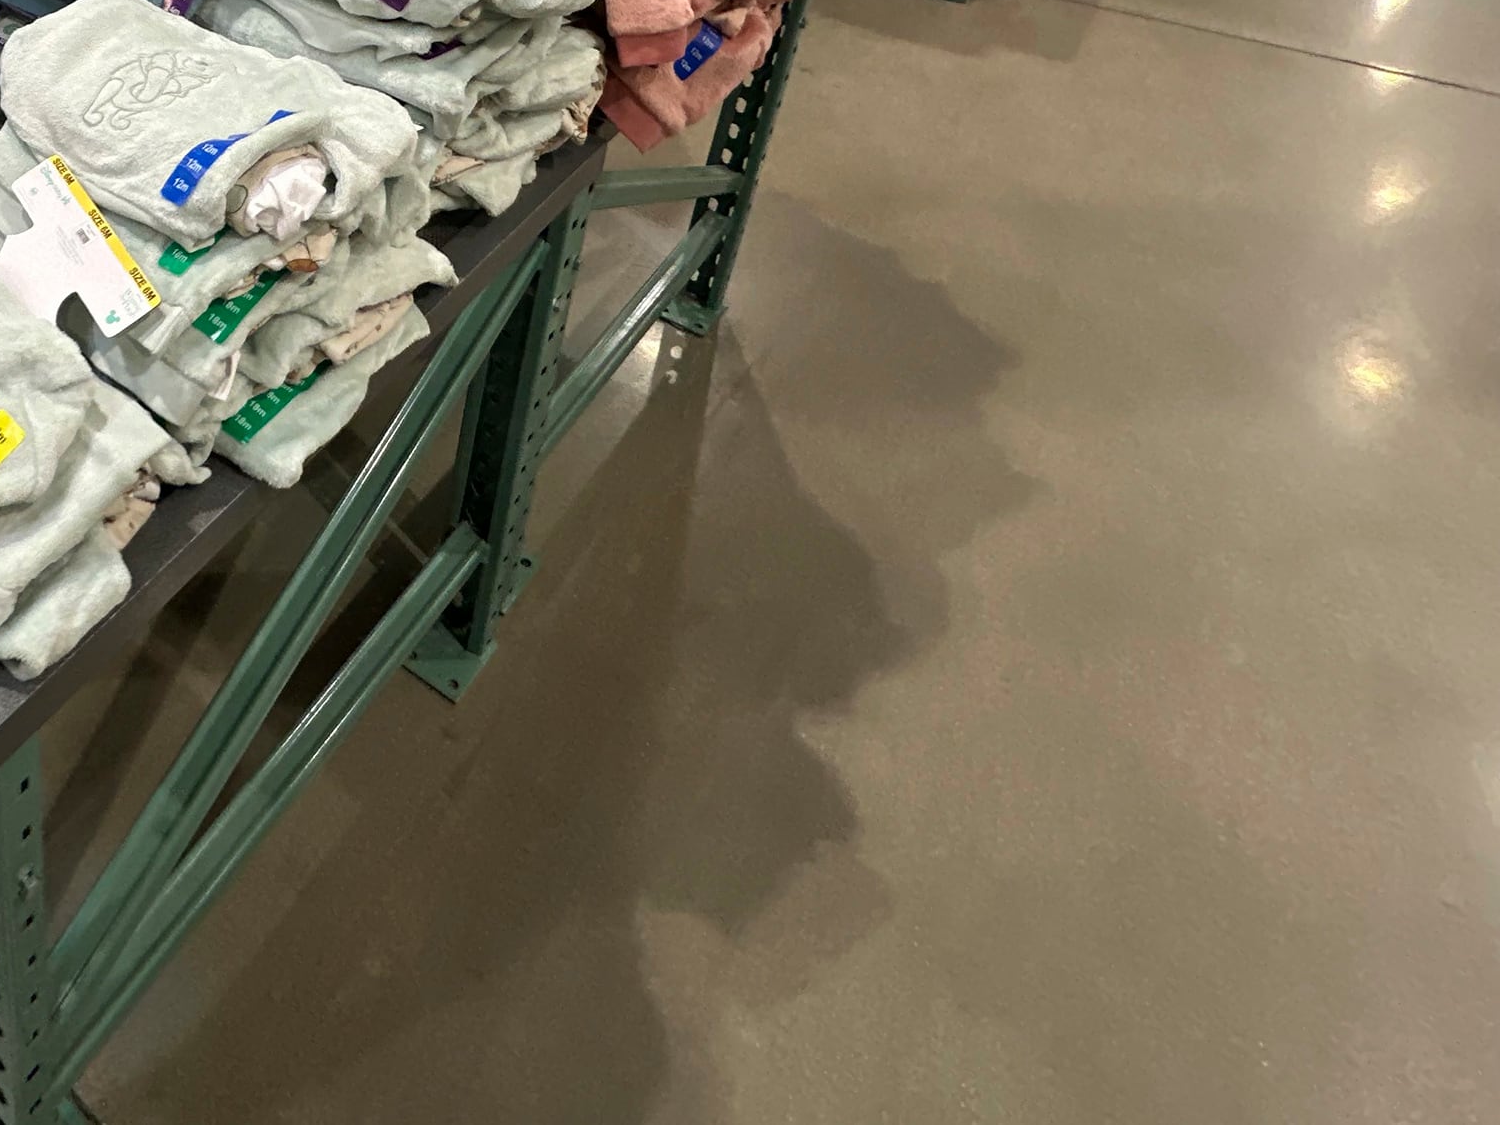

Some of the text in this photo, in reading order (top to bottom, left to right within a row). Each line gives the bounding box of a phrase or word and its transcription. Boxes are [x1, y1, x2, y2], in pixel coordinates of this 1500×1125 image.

[202, 143, 219, 156] 12m
[53, 158, 67, 175] SIZE
[62, 173, 75, 186] 6M
[187, 158, 202, 173] 12m
[172, 178, 189, 192] 12m
[88, 209, 113, 239] SIZE 6M
[129, 267, 147, 288] SIZE
[208, 313, 228, 331] 18m
[249, 400, 267, 418] 18m
[234, 414, 252, 431] 18m
